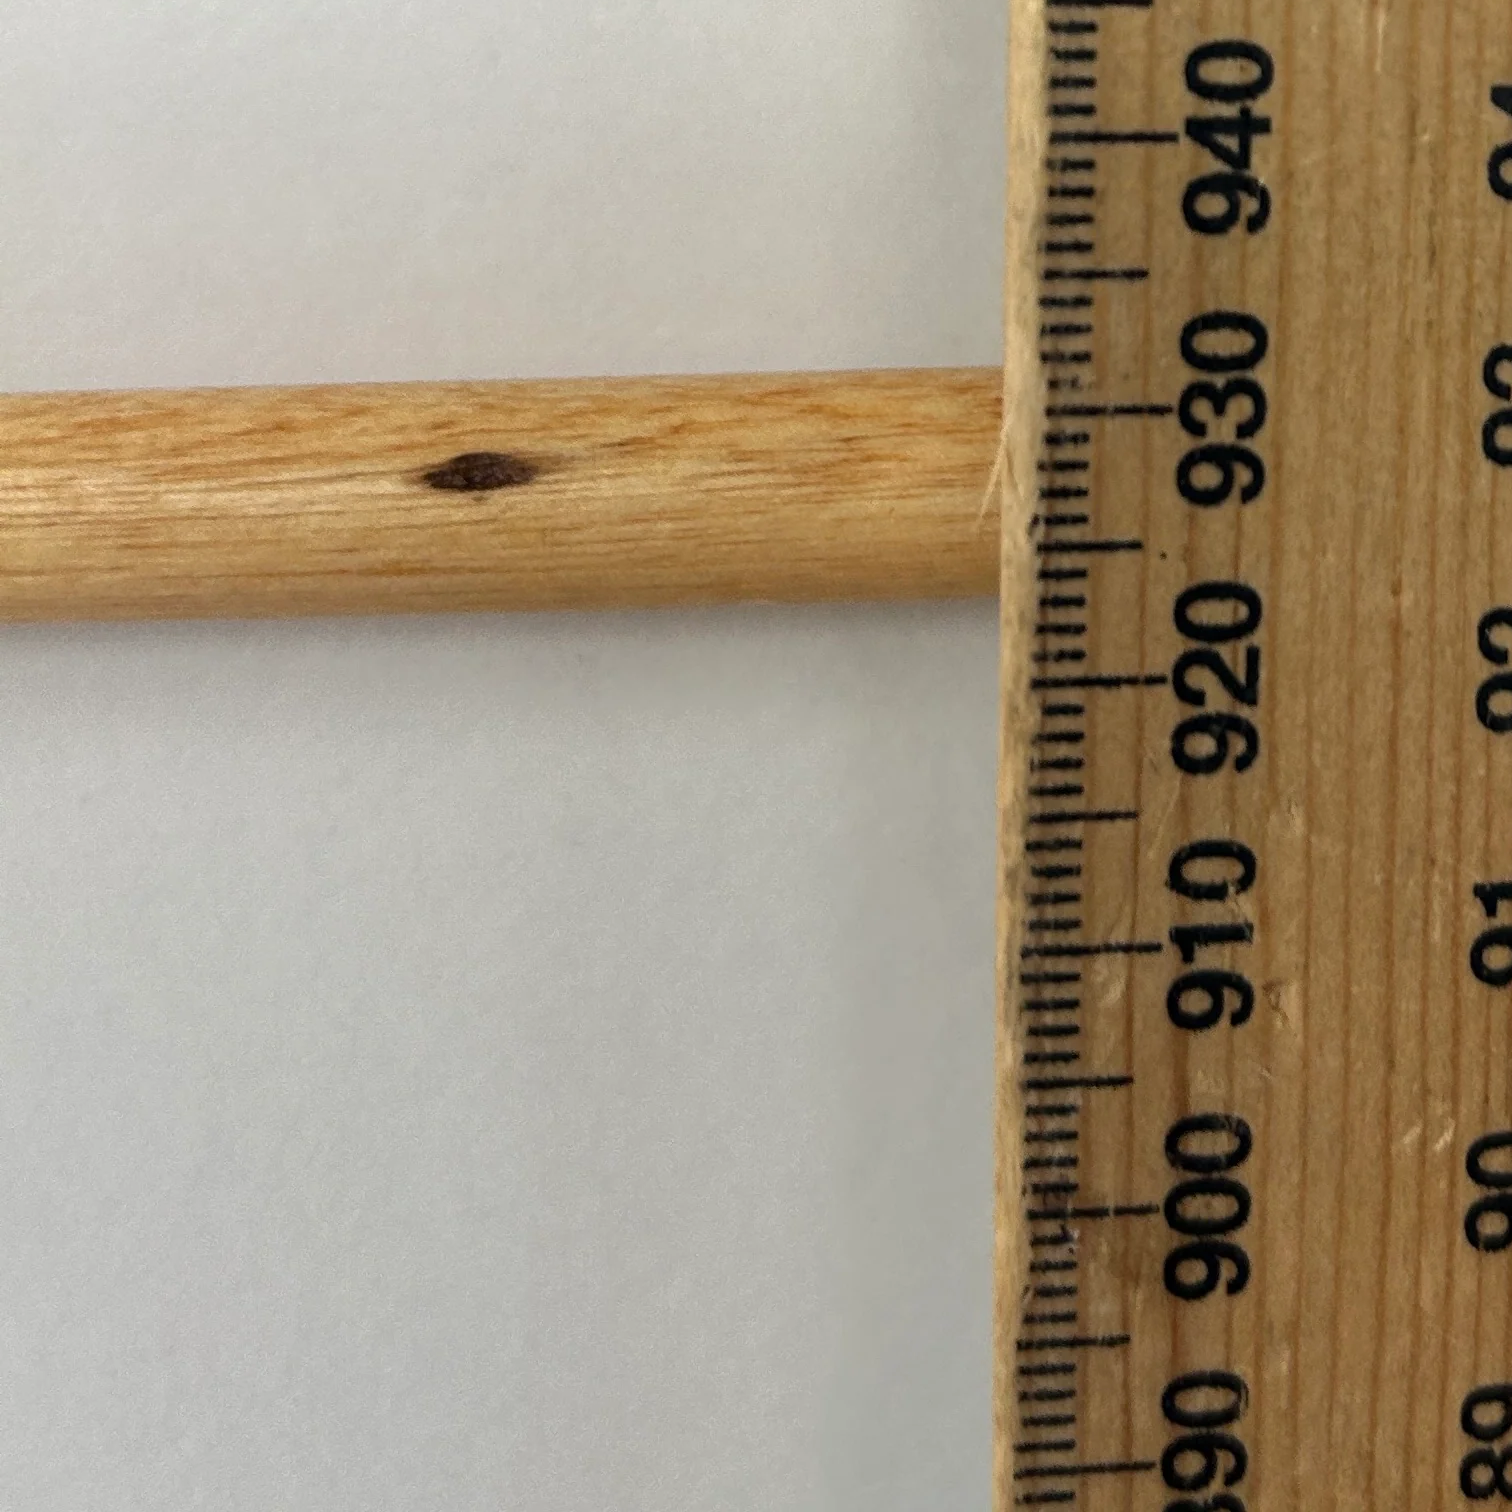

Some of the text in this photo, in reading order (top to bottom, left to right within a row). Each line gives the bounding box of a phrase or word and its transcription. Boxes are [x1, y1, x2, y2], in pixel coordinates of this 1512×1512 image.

[1180, 39, 1274, 240] 940
[1174, 309, 1268, 506] 930
[1169, 577, 1263, 781] 920
[1164, 838, 1257, 1032] 910
[1163, 1112, 1254, 1301] 900
[1160, 1369, 1250, 1512] 90
